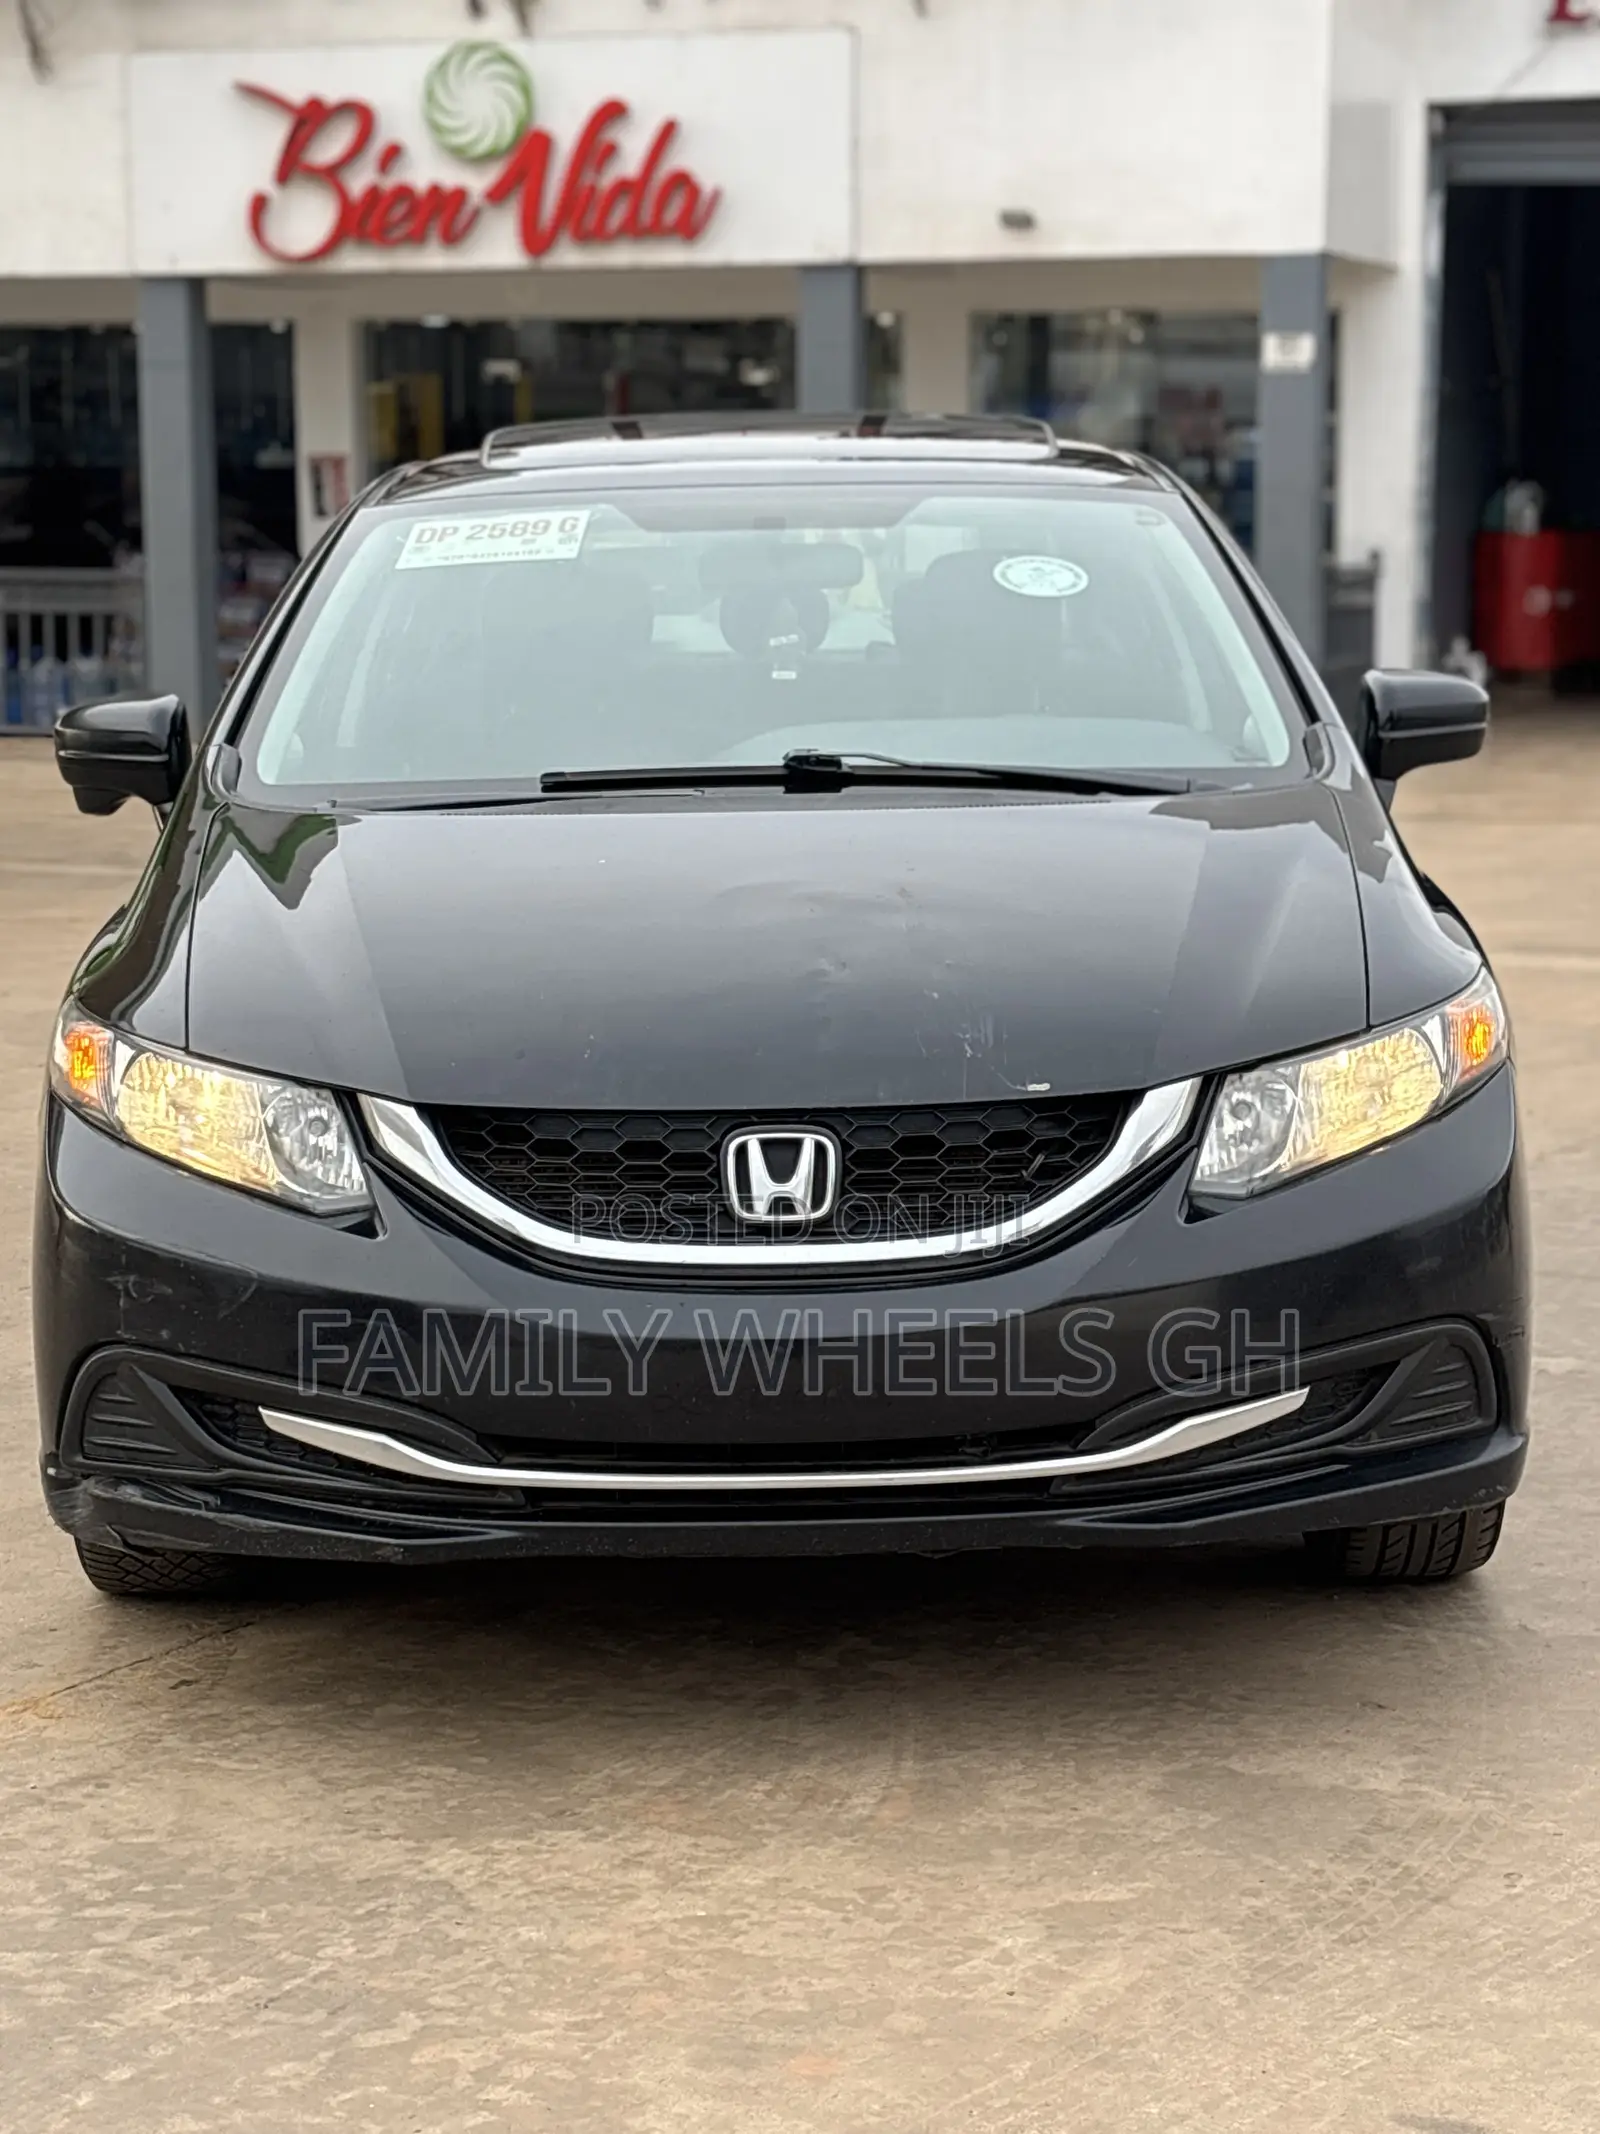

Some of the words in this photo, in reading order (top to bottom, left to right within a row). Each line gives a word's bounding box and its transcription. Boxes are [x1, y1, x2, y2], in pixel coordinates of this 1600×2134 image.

[233, 80, 480, 263] Bien
[485, 96, 721, 258] Vida
[414, 526, 460, 545] DP
[465, 518, 553, 541] 2589
[558, 516, 580, 534] G
